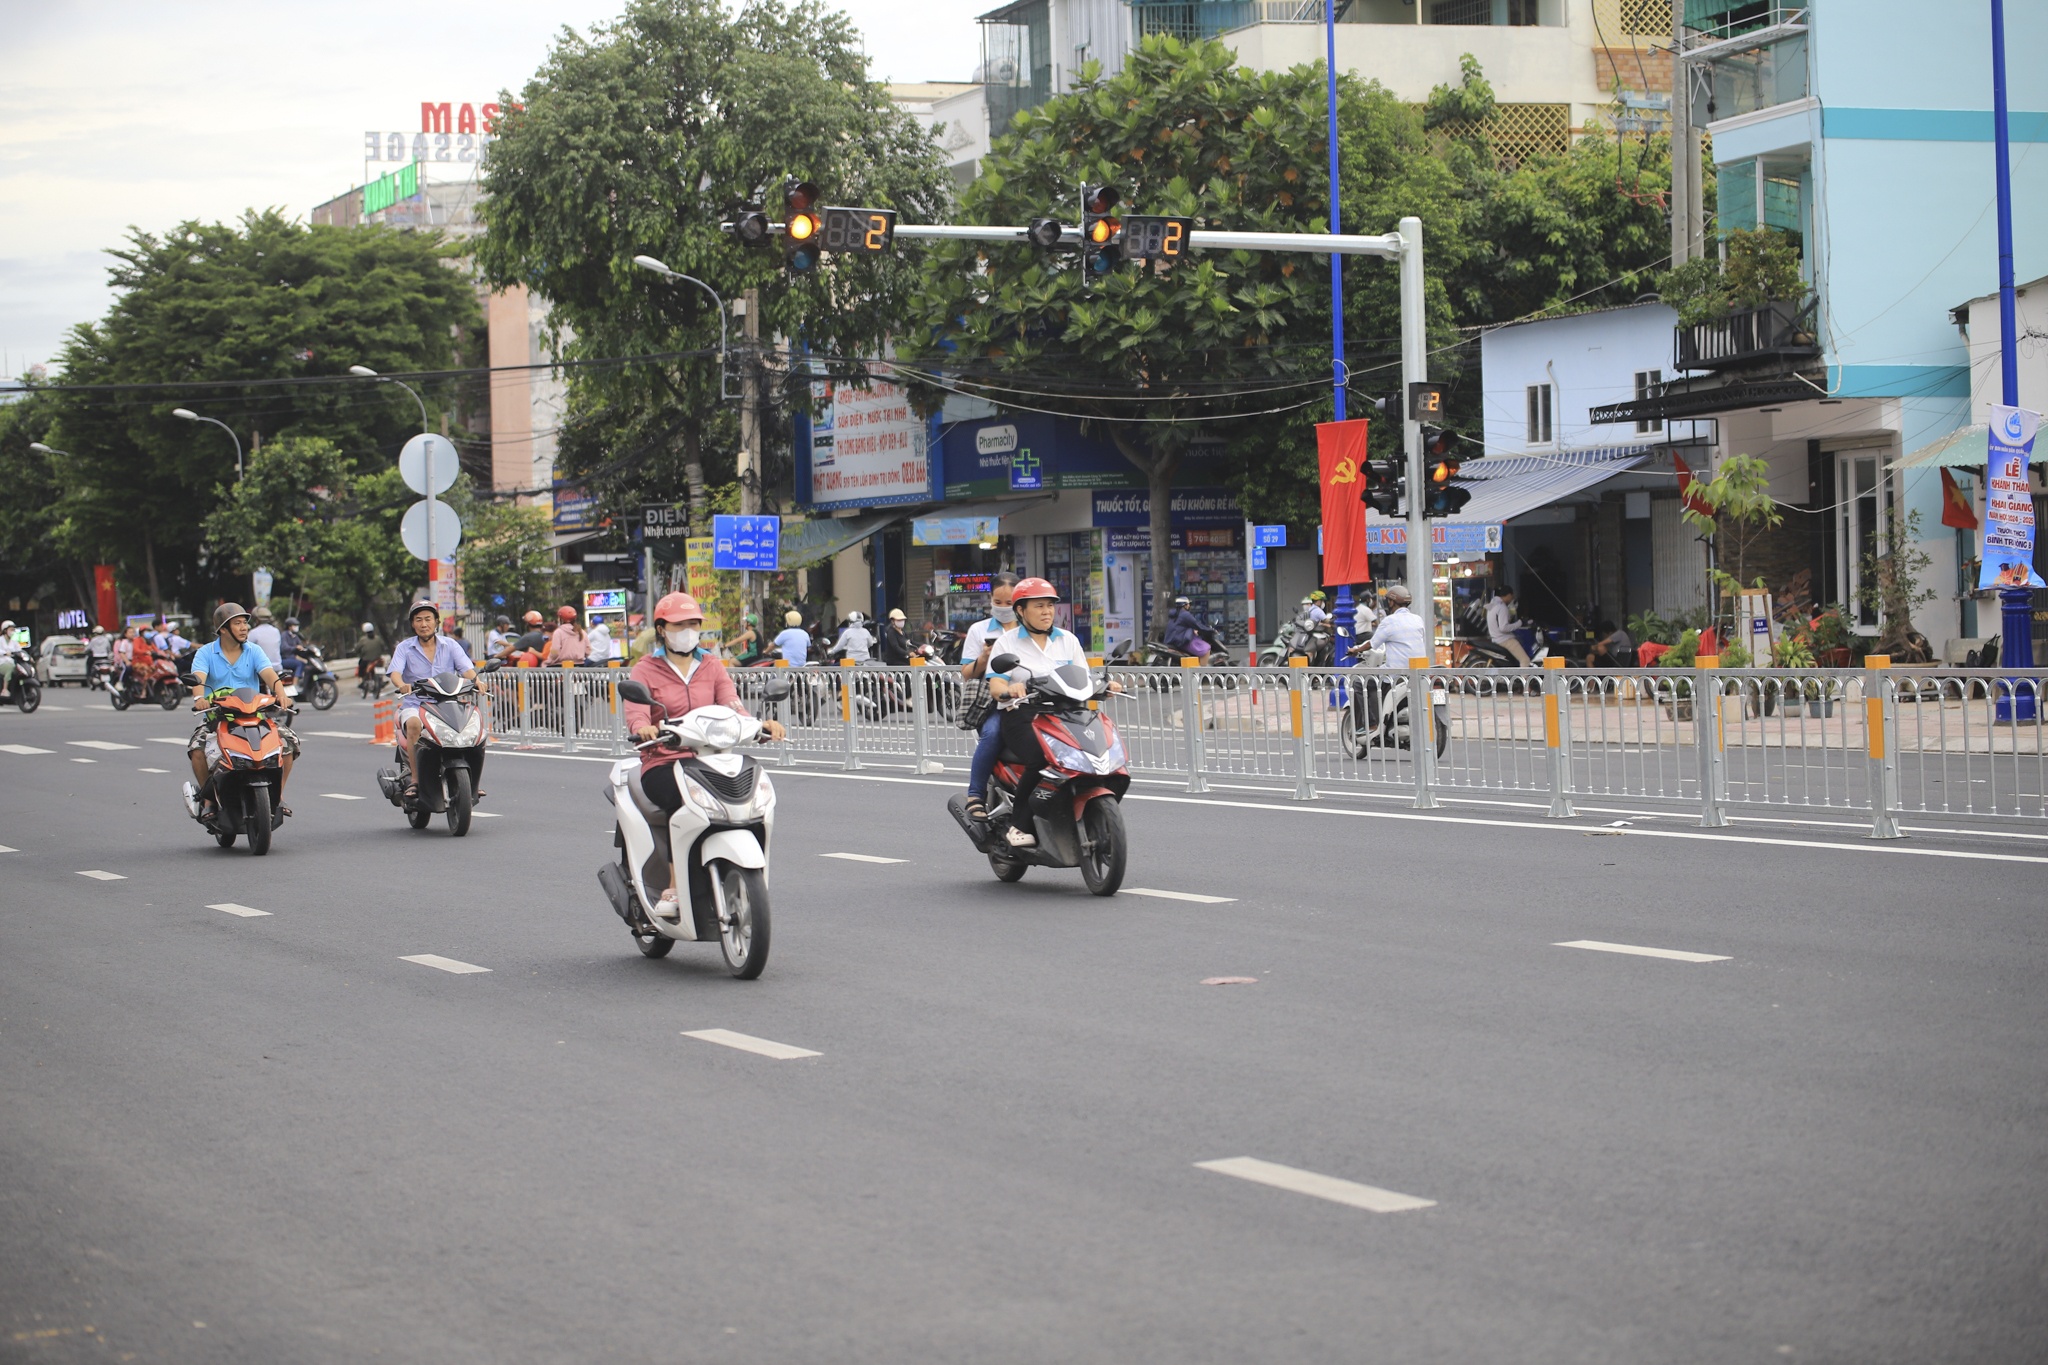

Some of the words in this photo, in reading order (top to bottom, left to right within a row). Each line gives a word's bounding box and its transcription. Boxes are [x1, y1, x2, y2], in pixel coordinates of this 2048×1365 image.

[865, 215, 887, 250] 2
[1163, 221, 1182, 255] 2
[1428, 391, 1440, 412] 2
[979, 429, 1015, 449] Pharmacity
[2005, 457, 2020, 477] LỄ
[1991, 478, 2011, 490] KHÁNH
[1096, 494, 1124, 513] THUỐC
[1124, 495, 1142, 514] TỐT,
[1171, 494, 1187, 511] NẾU
[1188, 496, 1217, 511] KHÔNG
[1992, 499, 2006, 510] KHAI
[645, 509, 687, 526] ĐIỆN
[644, 526, 664, 539] Nhật
[666, 526, 690, 538] quang
[1263, 533, 1270, 543] SỐ
[1987, 534, 2003, 544] BÌNH
[2014, 528, 2026, 538] THCS
[58, 609, 88, 630] HOTEL
